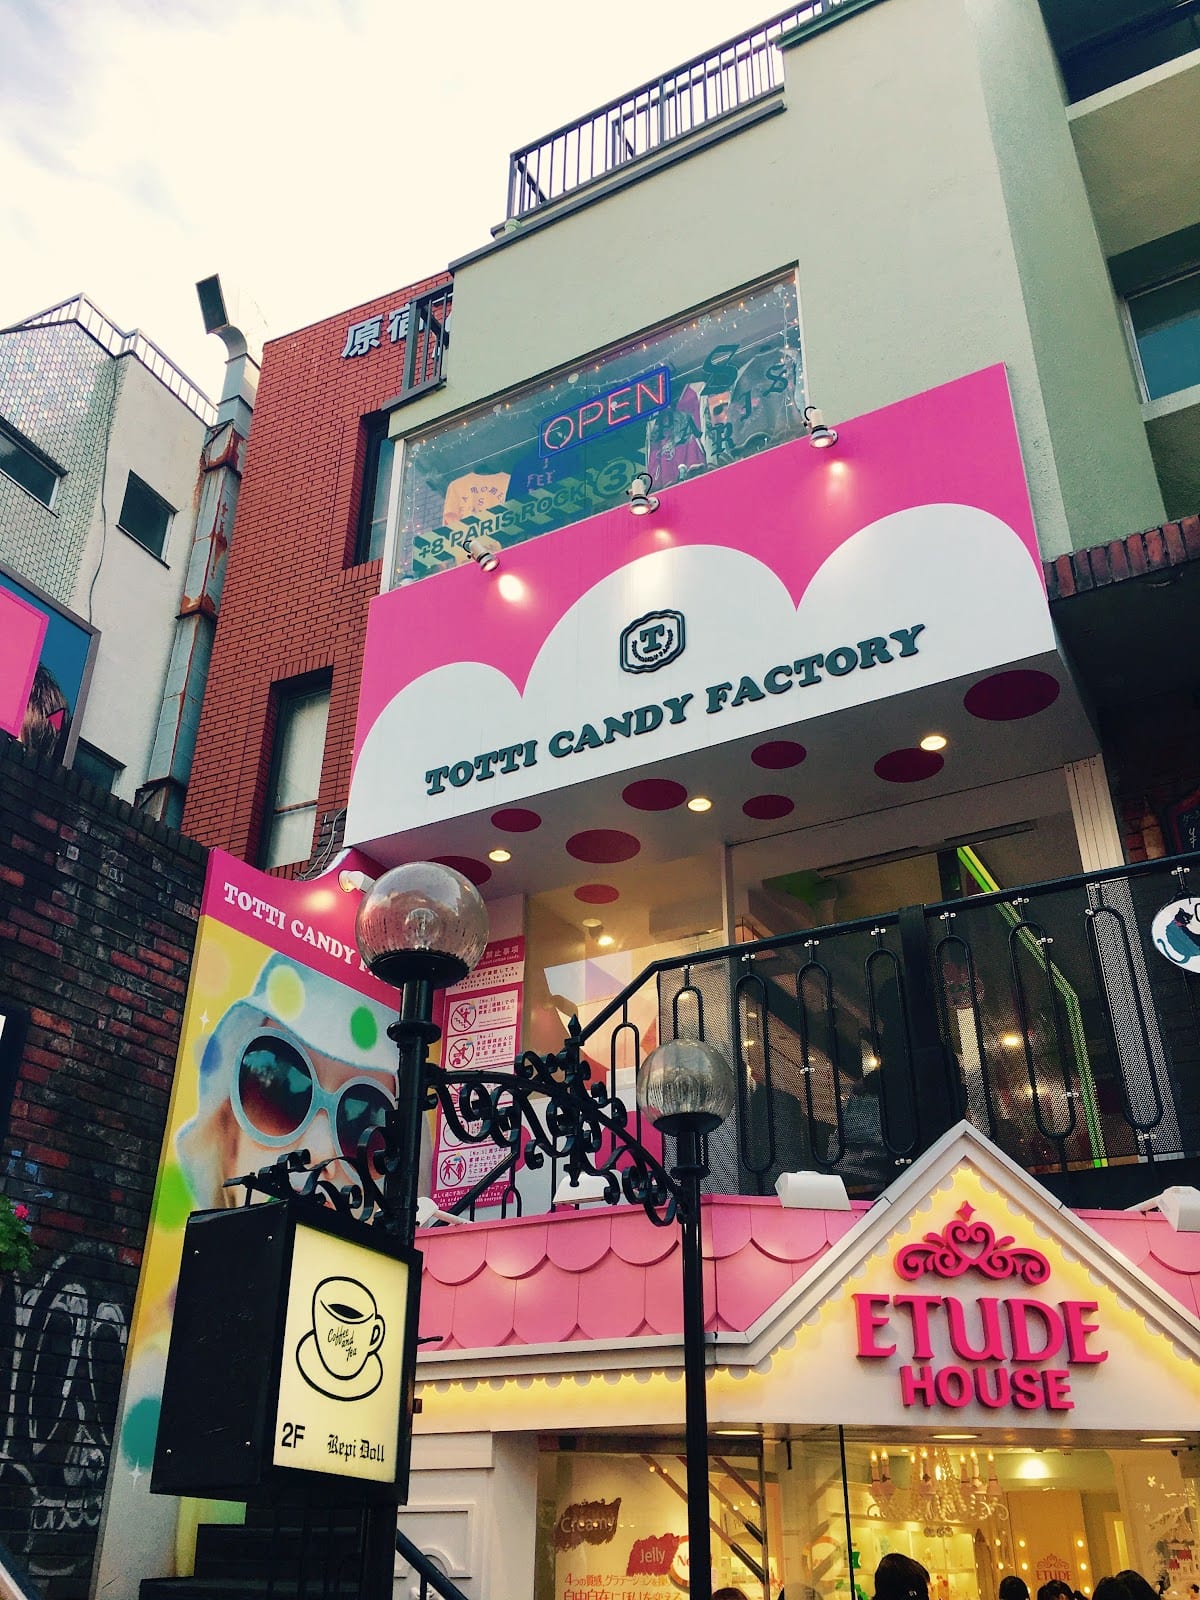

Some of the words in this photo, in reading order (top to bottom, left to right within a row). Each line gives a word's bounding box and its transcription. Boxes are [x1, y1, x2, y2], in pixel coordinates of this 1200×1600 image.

[341, 298, 440, 359] 原宿
[544, 373, 664, 450] OPEN
[450, 509, 518, 547] PARIS
[519, 484, 589, 521] ROCK
[639, 623, 665, 654] T
[424, 740, 538, 796] TOTTI
[548, 693, 694, 758] CANDY
[705, 623, 925, 716] FACTORY
[223, 881, 287, 931] TOTTI
[290, 919, 356, 965] CANDY
[327, 1325, 349, 1346] Coffee
[851, 1293, 1109, 1365] ETUDE
[900, 1365, 1075, 1411] HOUSE
[282, 1422, 306, 1448] 2F
[360, 1439, 385, 1462] Doll
[639, 1546, 666, 1564] Jelly
